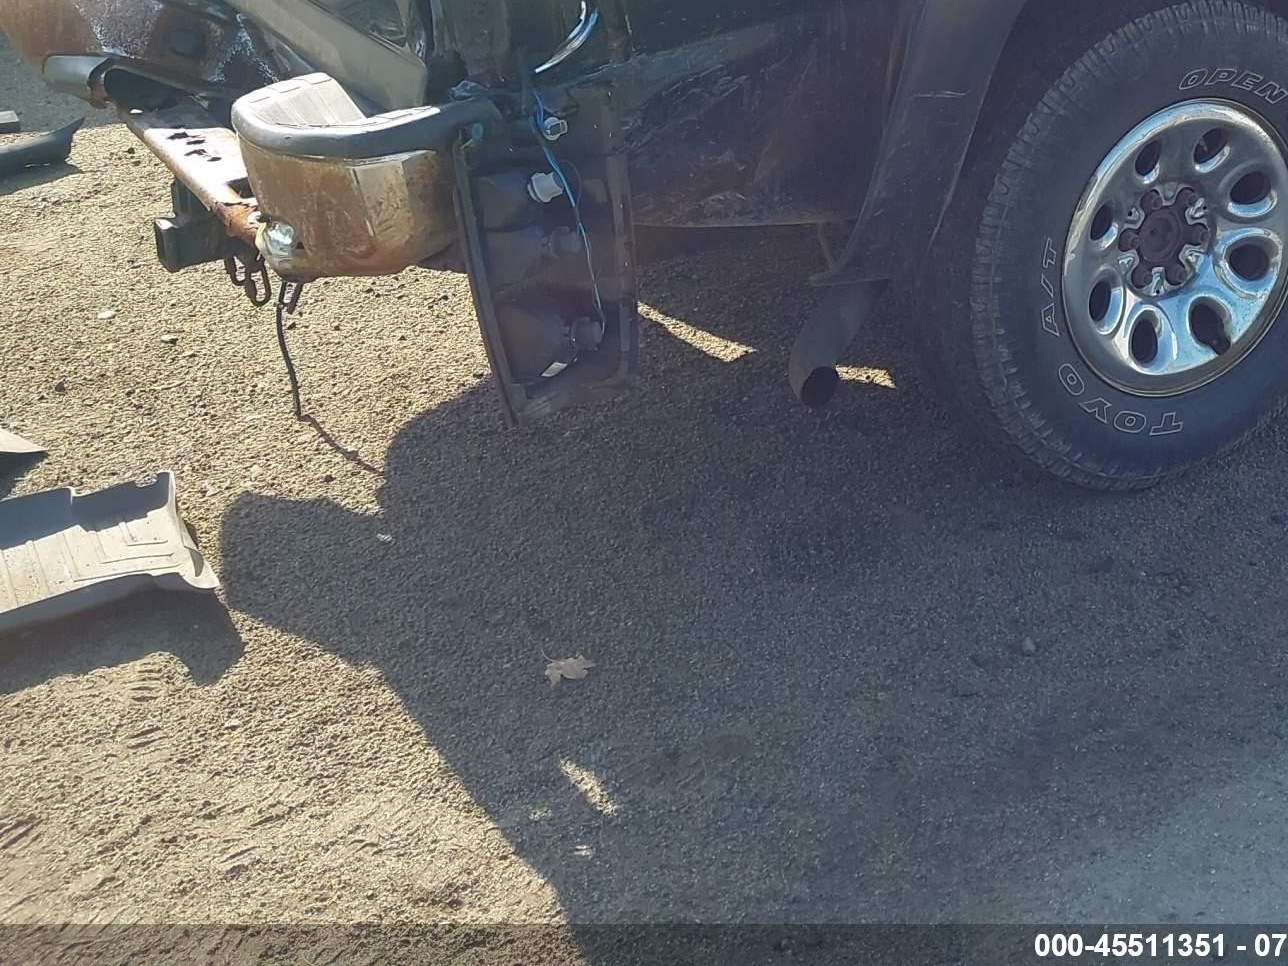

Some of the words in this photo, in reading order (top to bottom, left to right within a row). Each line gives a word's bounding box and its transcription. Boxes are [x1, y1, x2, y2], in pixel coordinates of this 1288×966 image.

[1178, 67, 1288, 104] OPEN
[1041, 238, 1060, 337] A/T
[1058, 363, 1183, 436] TOYO
